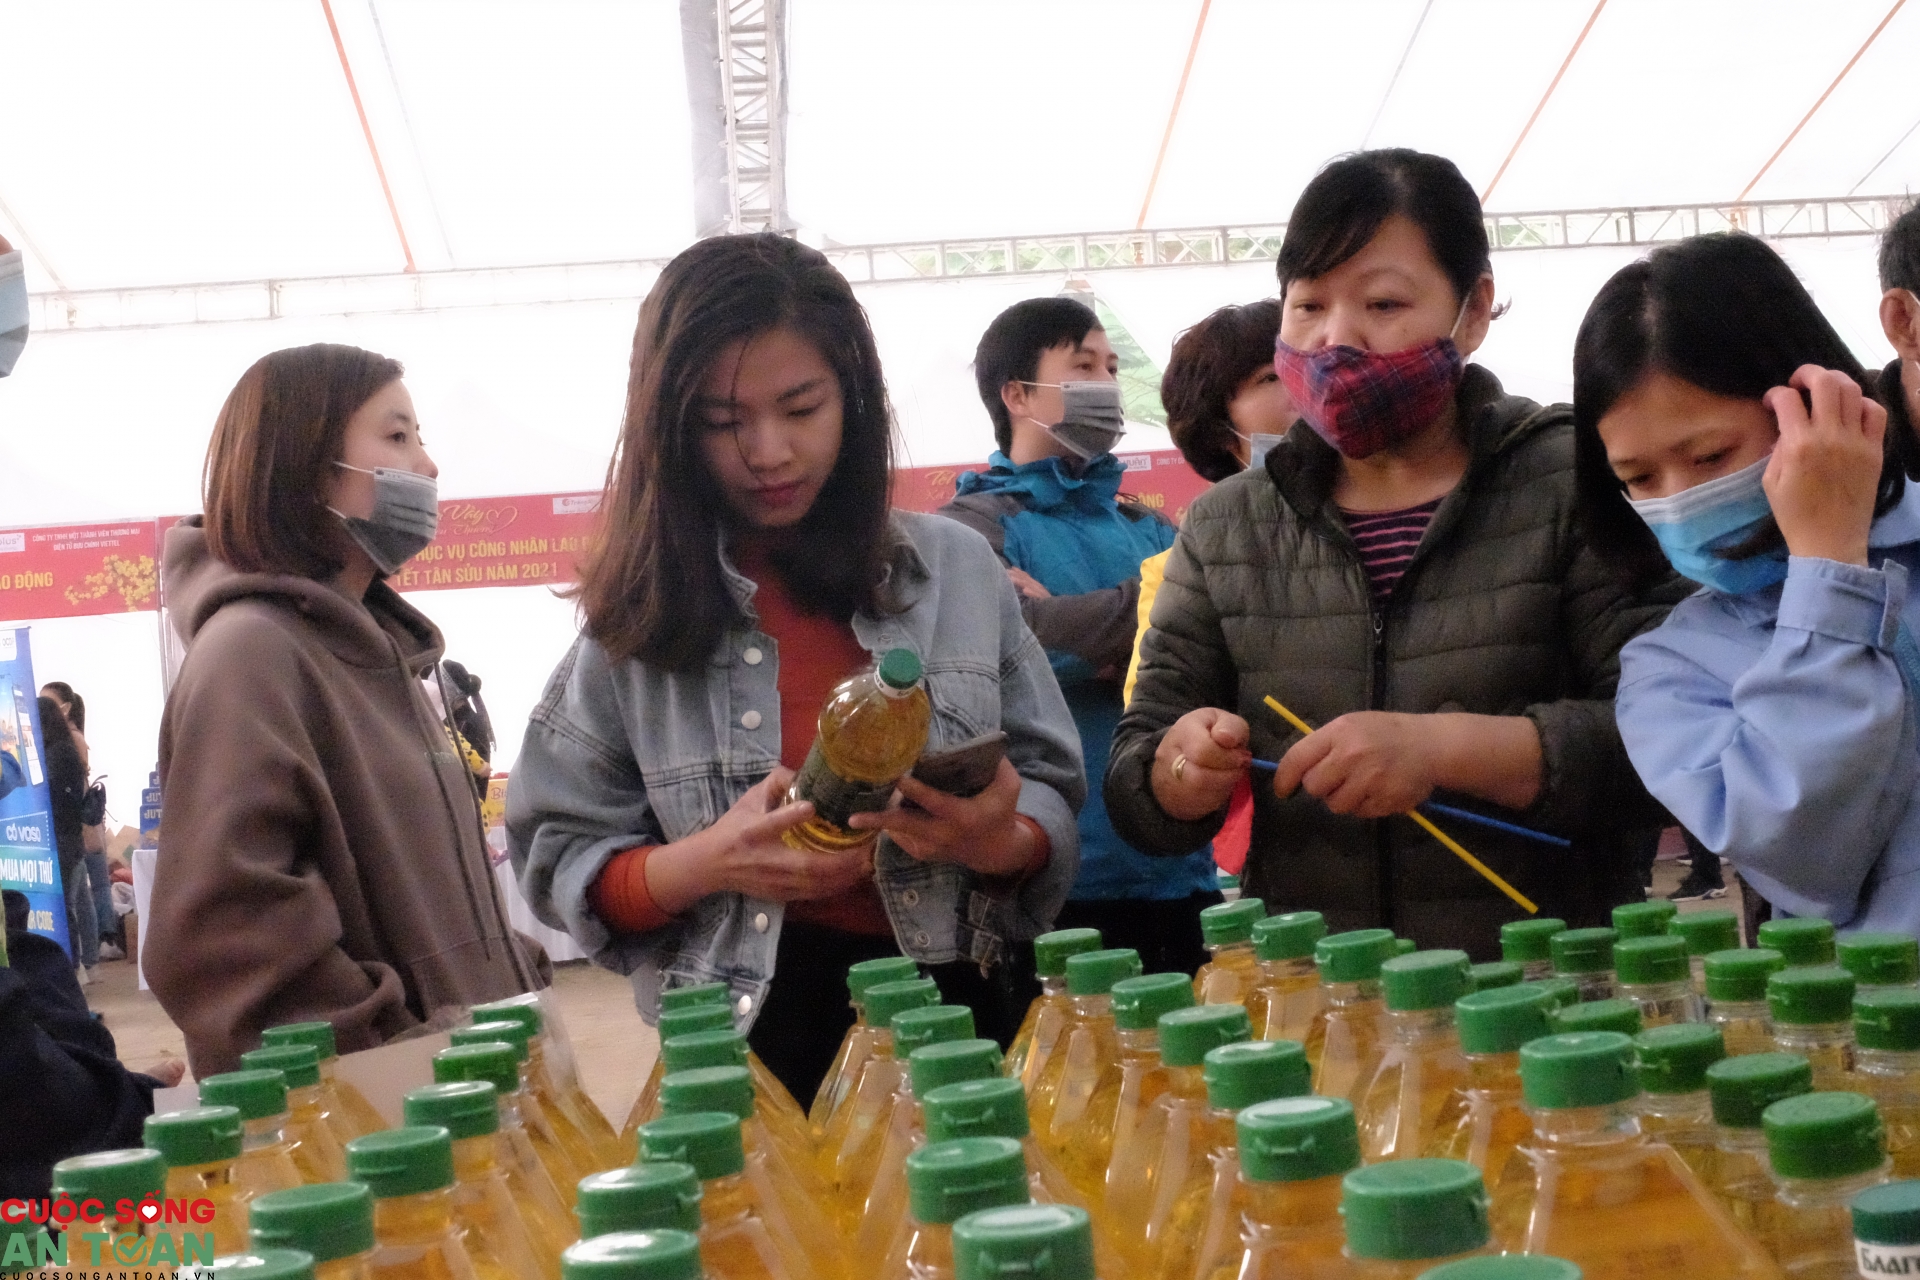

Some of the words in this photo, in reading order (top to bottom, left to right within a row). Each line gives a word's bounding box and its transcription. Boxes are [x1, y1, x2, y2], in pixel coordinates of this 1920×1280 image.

[447, 544, 466, 562] VỤ
[470, 540, 506, 558] CÔNG
[510, 538, 548, 555] NHÂN
[15, 571, 53, 591] ĐỘNG
[424, 567, 451, 585] TÂN
[487, 562, 518, 580] NĂM
[522, 561, 557, 579] 2021
[0, 858, 19, 882] MUA
[19, 860, 37, 888] MỌI
[38, 857, 53, 885] THỨ
